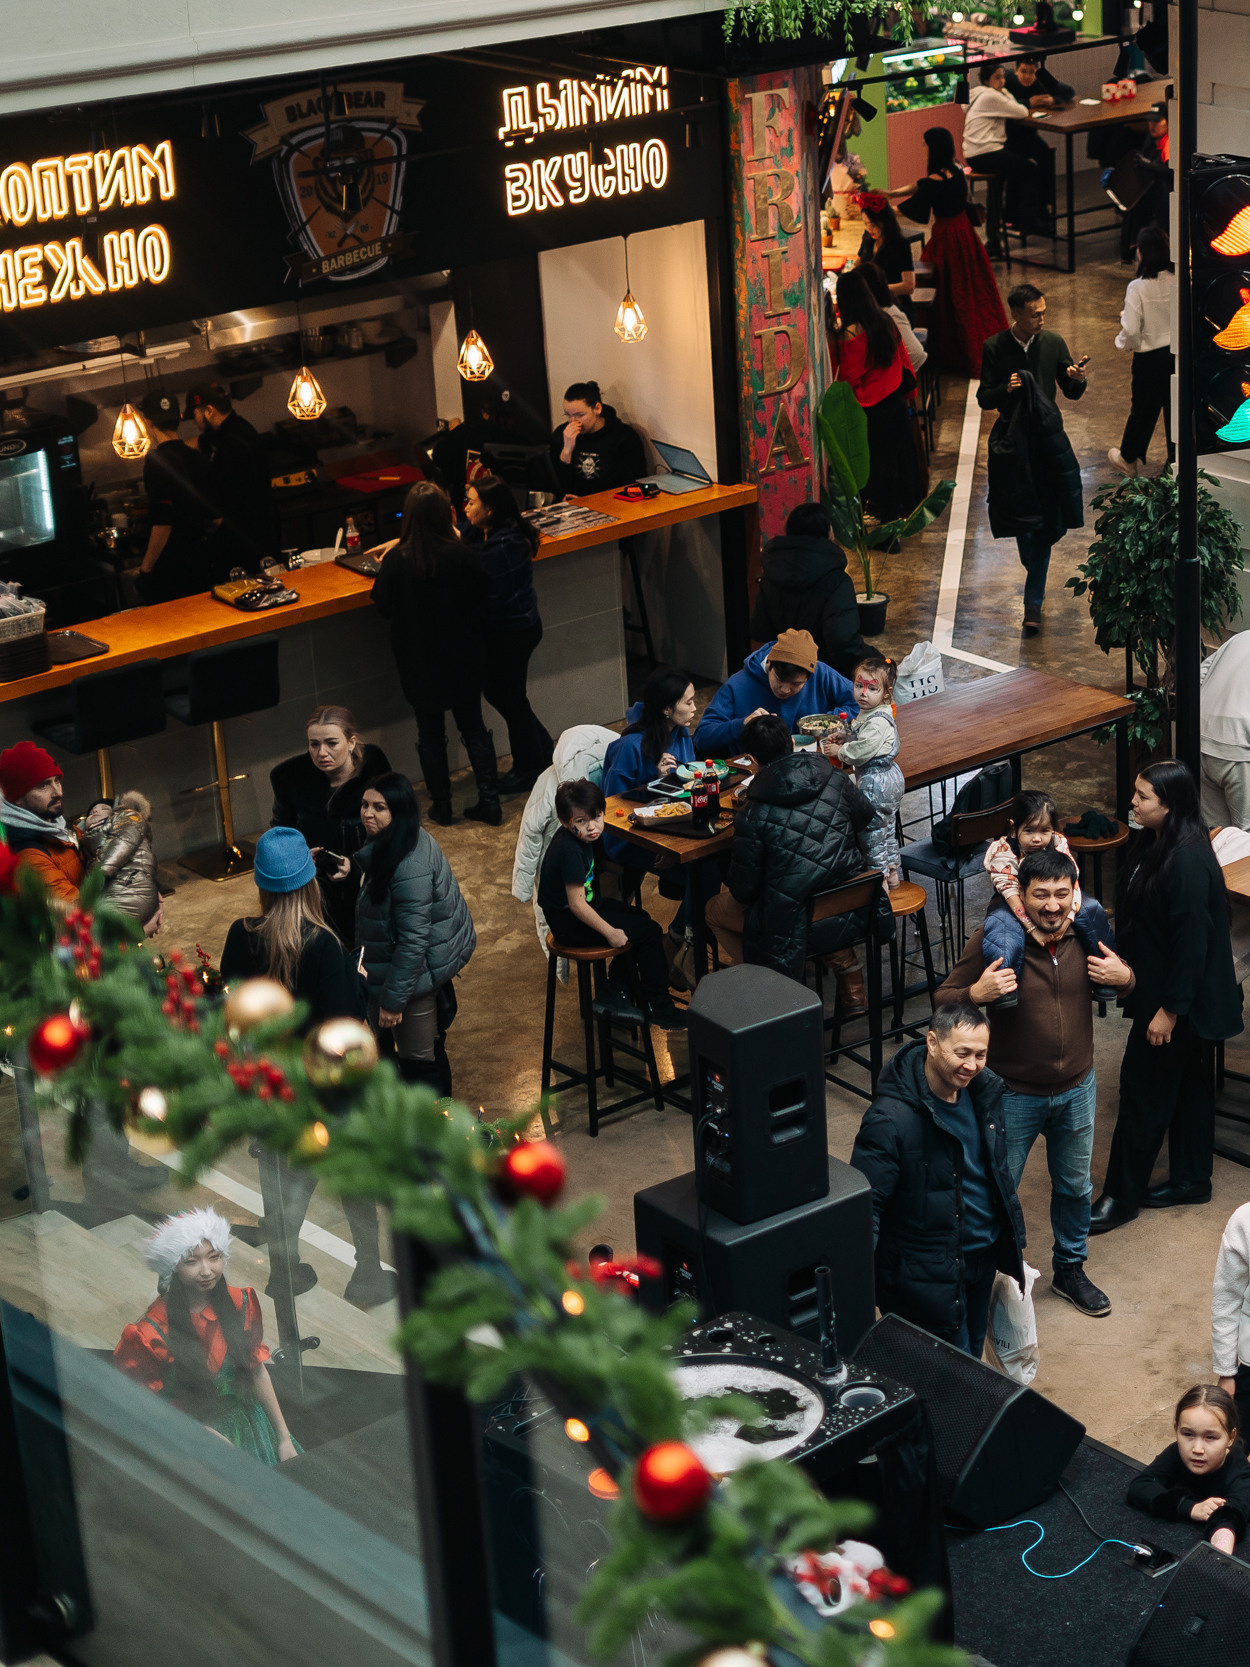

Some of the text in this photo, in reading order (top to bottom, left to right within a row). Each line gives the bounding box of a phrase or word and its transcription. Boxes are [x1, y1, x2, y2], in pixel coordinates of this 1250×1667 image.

[499, 66, 669, 147] ДЫМИМ
[0, 139, 176, 228] ОПТИМ
[504, 138, 668, 216] ВКУСНО
[321, 242, 383, 274] BARBECUE
[744, 87, 810, 475] FRIDA
